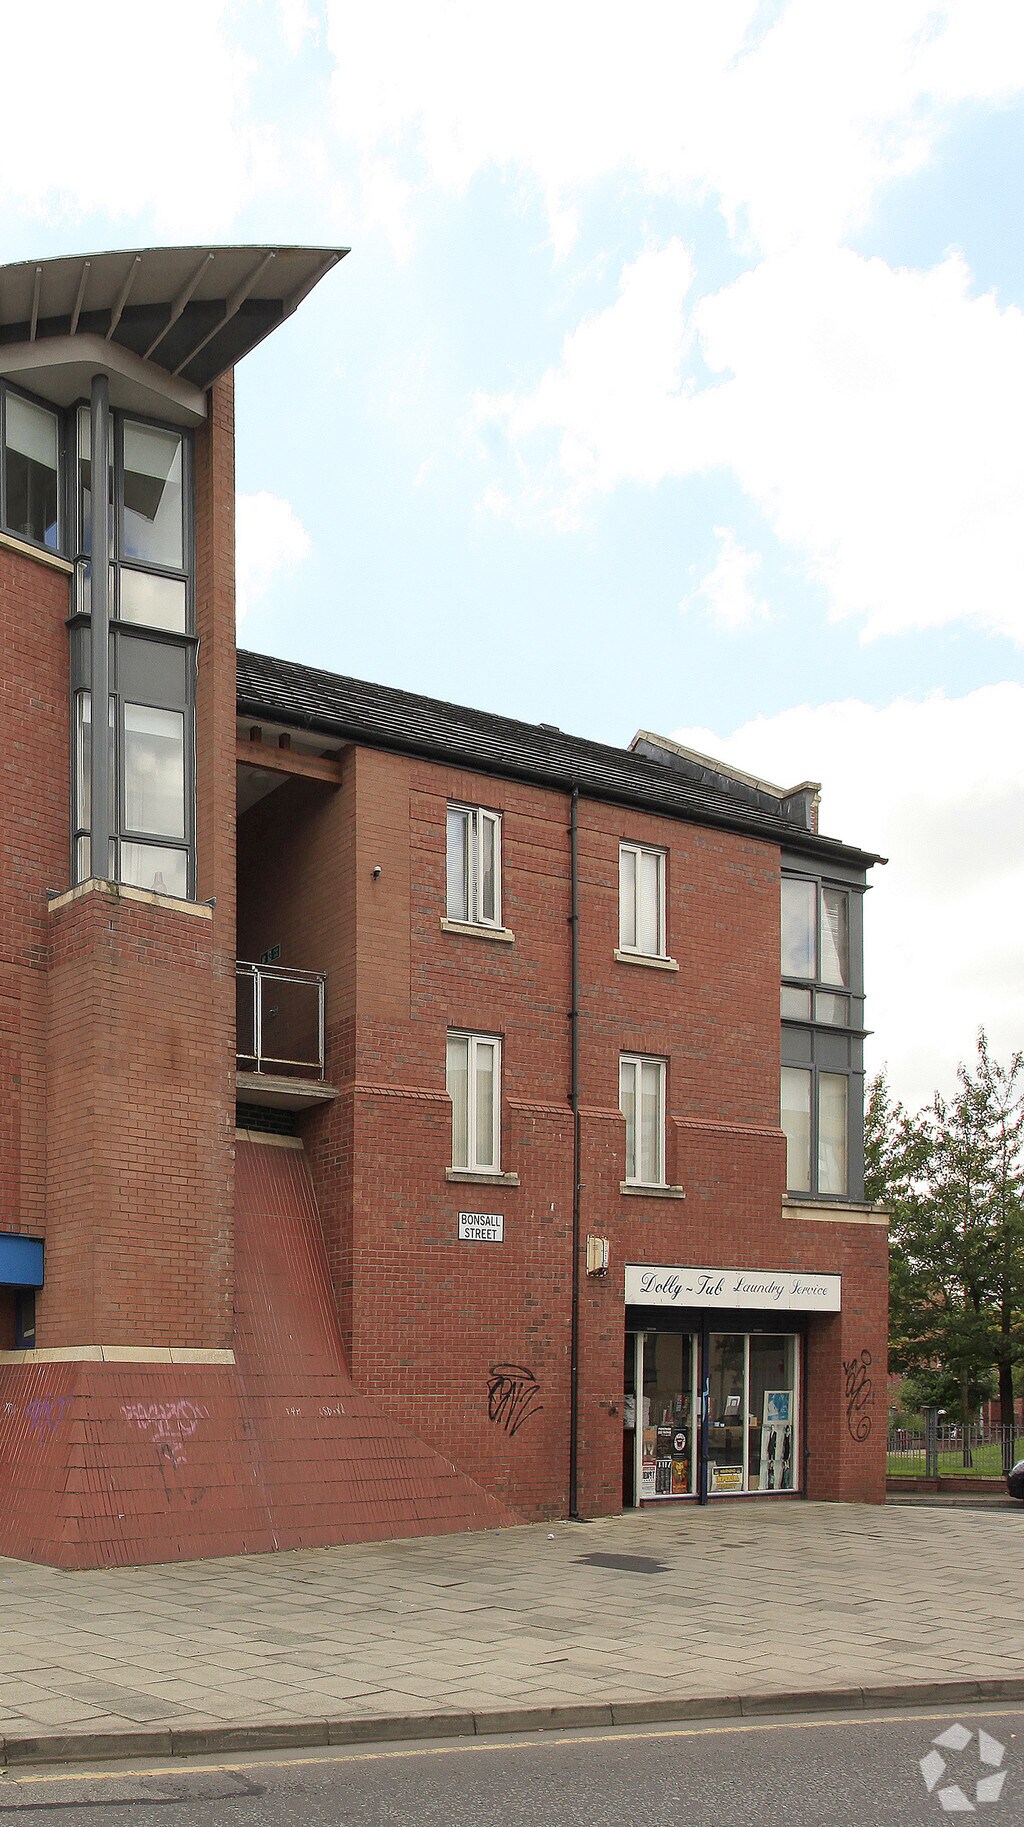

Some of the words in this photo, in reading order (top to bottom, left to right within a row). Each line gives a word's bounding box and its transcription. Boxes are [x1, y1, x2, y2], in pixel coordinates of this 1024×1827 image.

[461, 1214, 501, 1227] BONSALL
[464, 1227, 497, 1240] STREET
[733, 1275, 785, 1300] Laundry
[789, 1278, 828, 1296] Service
